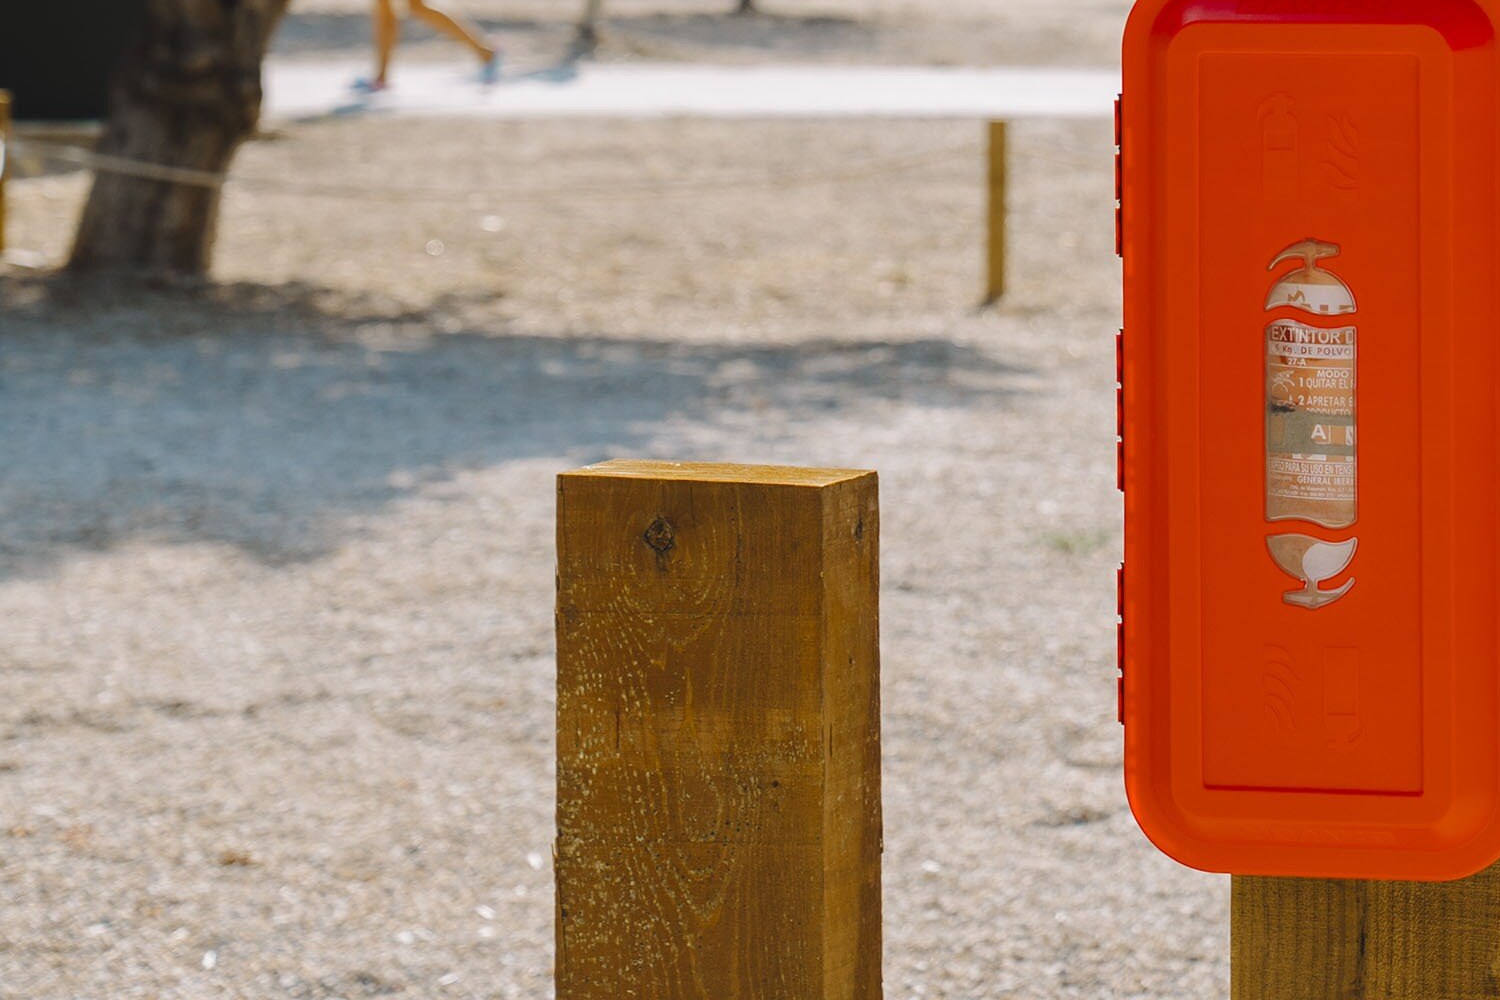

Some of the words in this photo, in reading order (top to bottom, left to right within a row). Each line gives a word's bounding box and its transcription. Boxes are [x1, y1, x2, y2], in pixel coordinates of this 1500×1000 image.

[1271, 326, 1341, 344] EXTINTOR
[1300, 347, 1313, 355] DE
[1317, 347, 1351, 356] POLVO
[1316, 370, 1349, 378] MODO
[1299, 377, 1304, 388] 1
[1306, 378, 1337, 389] QUITAR
[1339, 379, 1349, 389] EL
[1298, 395, 1305, 406] 2
[1306, 396, 1346, 407] APRETAR
[1311, 424, 1327, 440] A
[1300, 462, 1310, 473] SU
[1310, 463, 1324, 474] USO
[1325, 463, 1334, 474] EN
[1297, 475, 1331, 485] GENERAL
